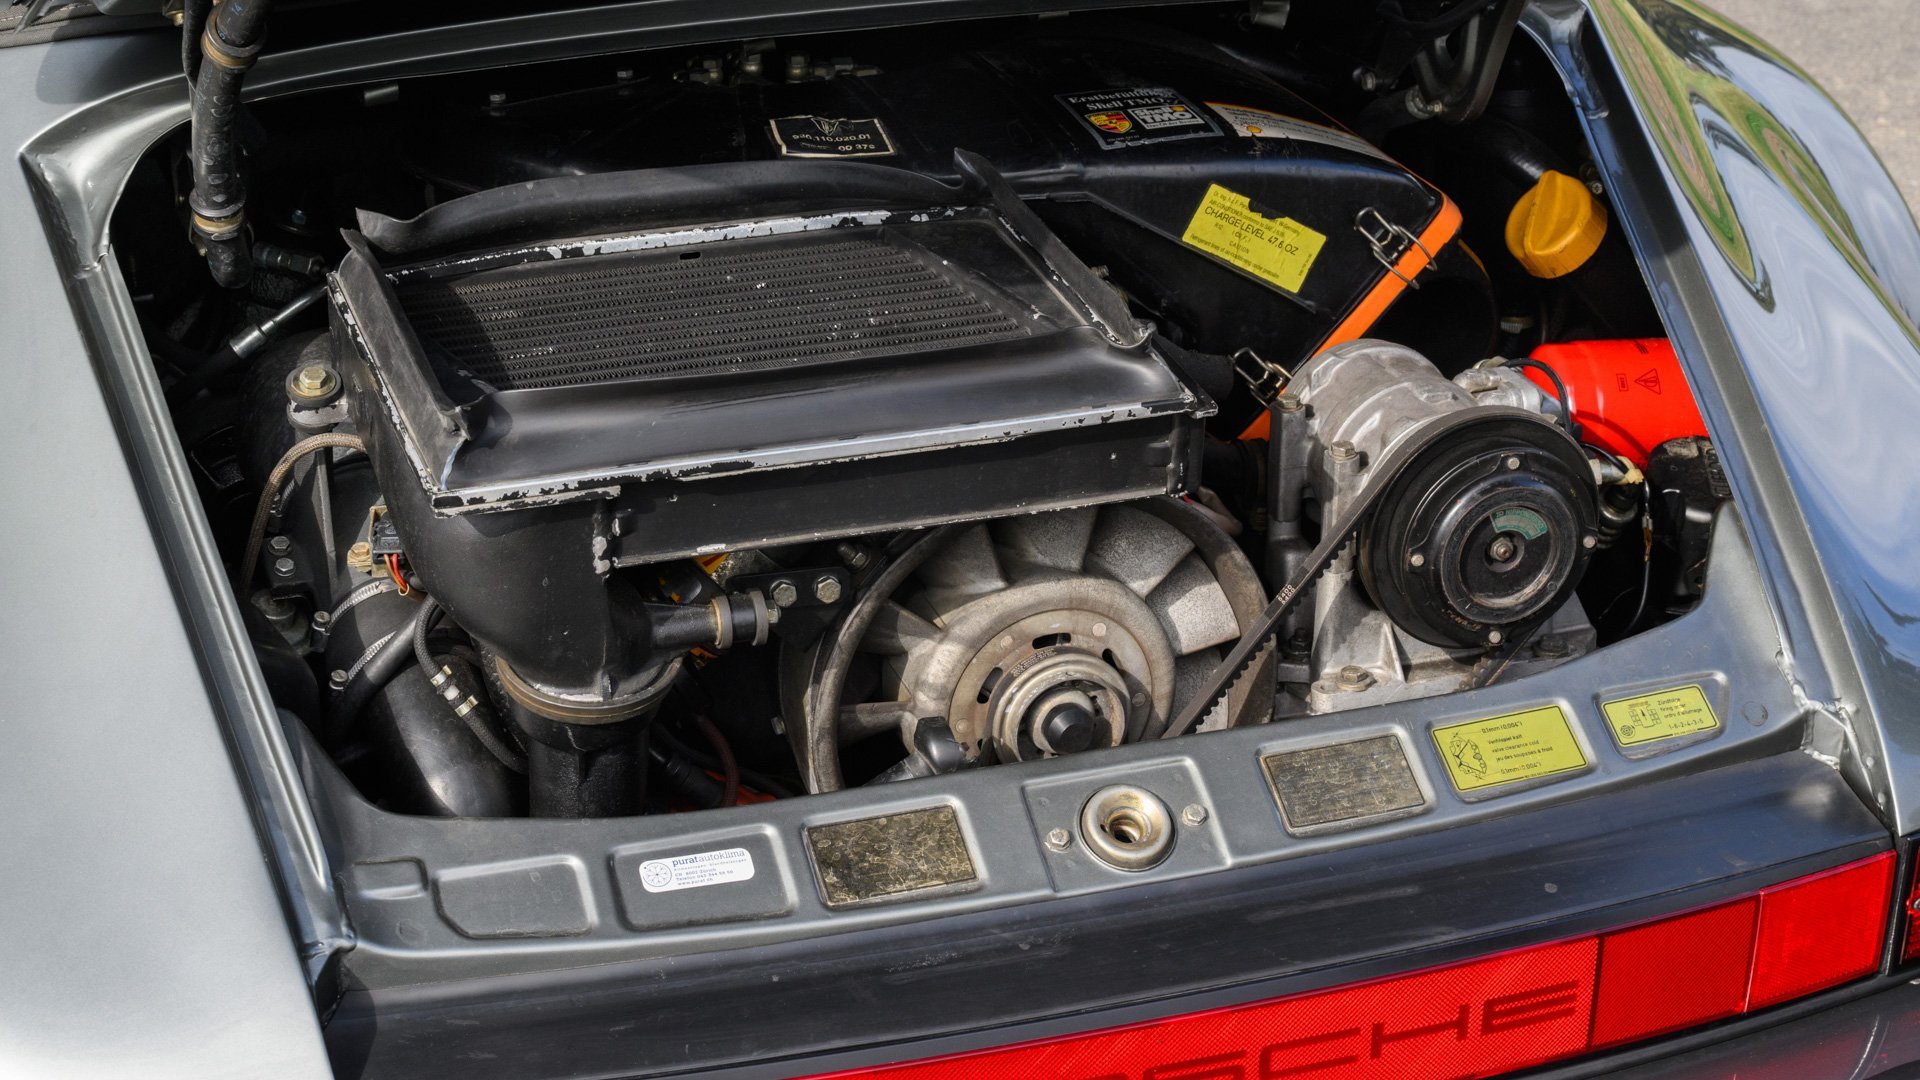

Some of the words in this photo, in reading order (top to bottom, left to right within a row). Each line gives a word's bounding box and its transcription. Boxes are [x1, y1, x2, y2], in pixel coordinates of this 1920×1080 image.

[1086, 100, 1126, 110] Shell
[1124, 96, 1164, 106] TMO
[1134, 107, 1173, 116] Shell
[1139, 112, 1192, 123] TMO
[1204, 205, 1240, 227] CHARGE
[1240, 222, 1266, 239] LEVEL
[1284, 243, 1298, 255] OZ
[1504, 742, 1528, 750] clearance
